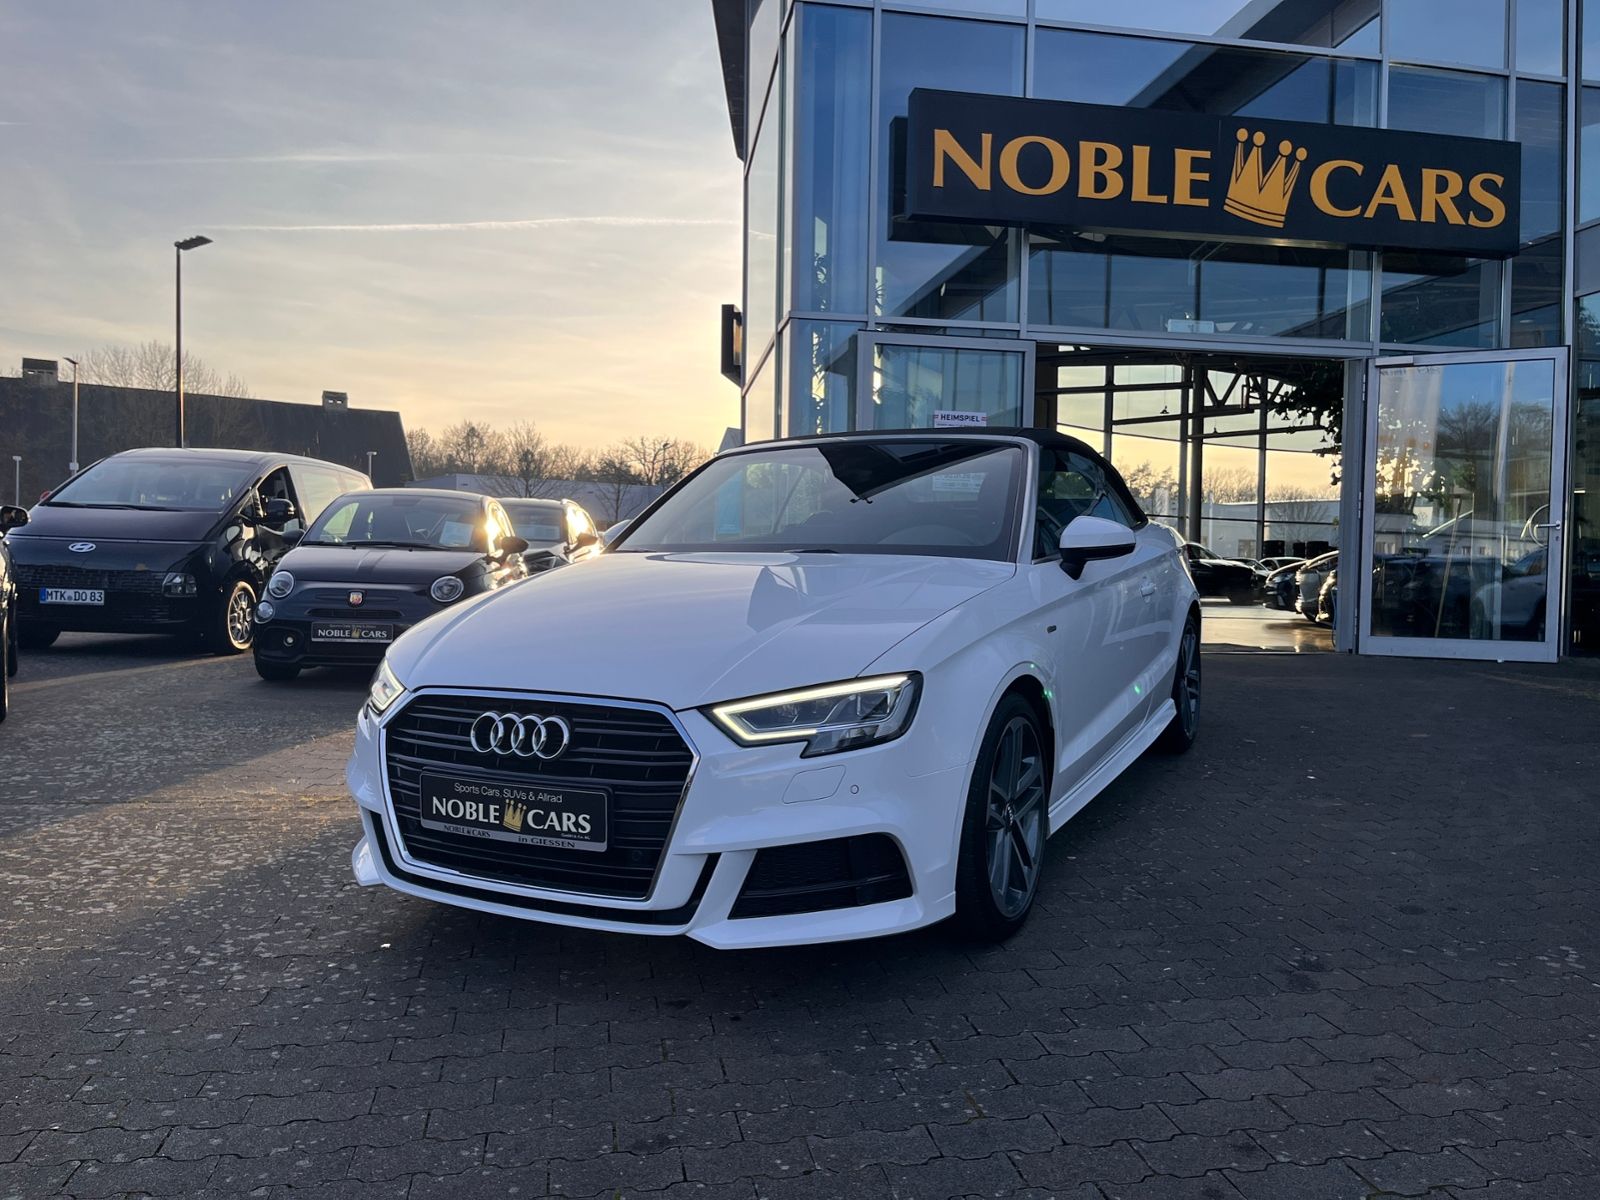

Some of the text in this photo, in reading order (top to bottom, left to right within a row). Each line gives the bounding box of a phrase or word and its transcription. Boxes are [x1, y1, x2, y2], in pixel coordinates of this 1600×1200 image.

[932, 127, 1507, 229] NOBLE CARS
[940, 414, 980, 422] HEIMSPIEL
[46, 591, 103, 602] MTK DO 83
[318, 629, 388, 638] NOBLE CARS
[454, 783, 479, 795] Sports
[503, 788, 527, 800] SUVs
[528, 791, 536, 800] &
[537, 792, 563, 803] Allrad
[432, 796, 592, 834] NOBLE CARS
[472, 829, 491, 838] CARS
[517, 835, 528, 843] in
[530, 837, 576, 848] GIESSEN
